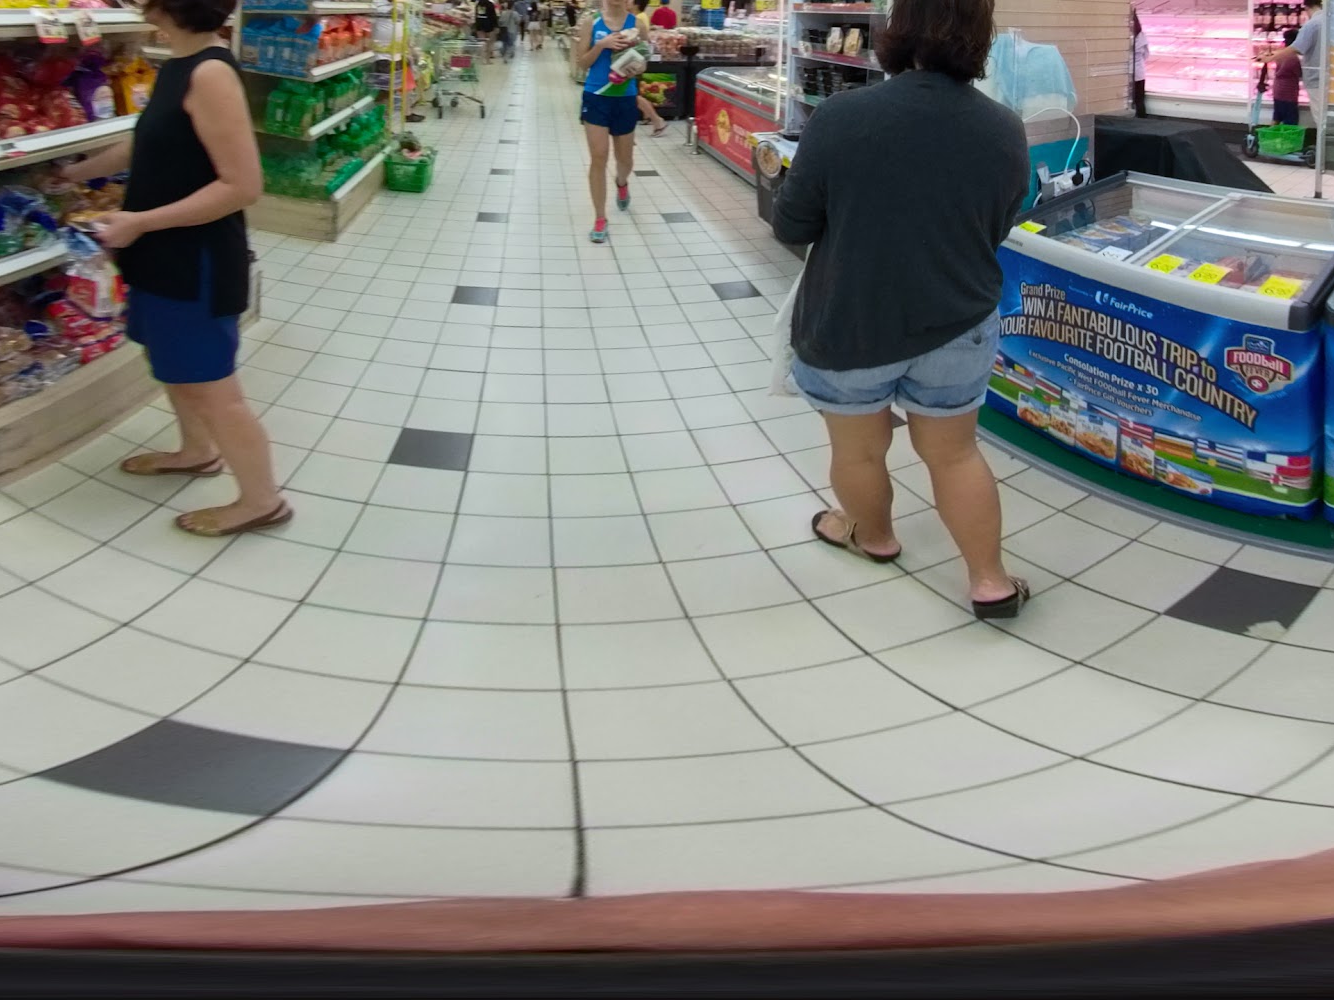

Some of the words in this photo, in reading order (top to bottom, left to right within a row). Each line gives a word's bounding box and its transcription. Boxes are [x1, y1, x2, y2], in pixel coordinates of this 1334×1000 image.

[1020, 282, 1043, 297] Grand
[1045, 284, 1066, 300] Prize
[1110, 297, 1153, 319] FairPrice
[1022, 297, 1046, 316] WIN
[1046, 300, 1055, 319] A
[1057, 301, 1158, 355] FANTABULOUS
[1159, 336, 1198, 370] TRIP
[1201, 360, 1217, 383] to
[1000, 316, 1026, 336] YOUR
[1028, 317, 1094, 352] FAVOURITE
[1096, 335, 1172, 384] FOOTBALL
[1174, 368, 1257, 428] COUNTRY
[1063, 353, 1110, 380] Consolation
[1111, 375, 1135, 390] Prize
[1145, 385, 1159, 397] 30
[1233, 351, 1284, 374] FOODball
[1028, 349, 1056, 367] Exclusive
[1056, 361, 1077, 377] Pacific
[1077, 370, 1093, 384] West
[1127, 391, 1150, 405] Fever
[1151, 398, 1203, 422] Merchandise
[1116, 398, 1153, 417] Vouchers
